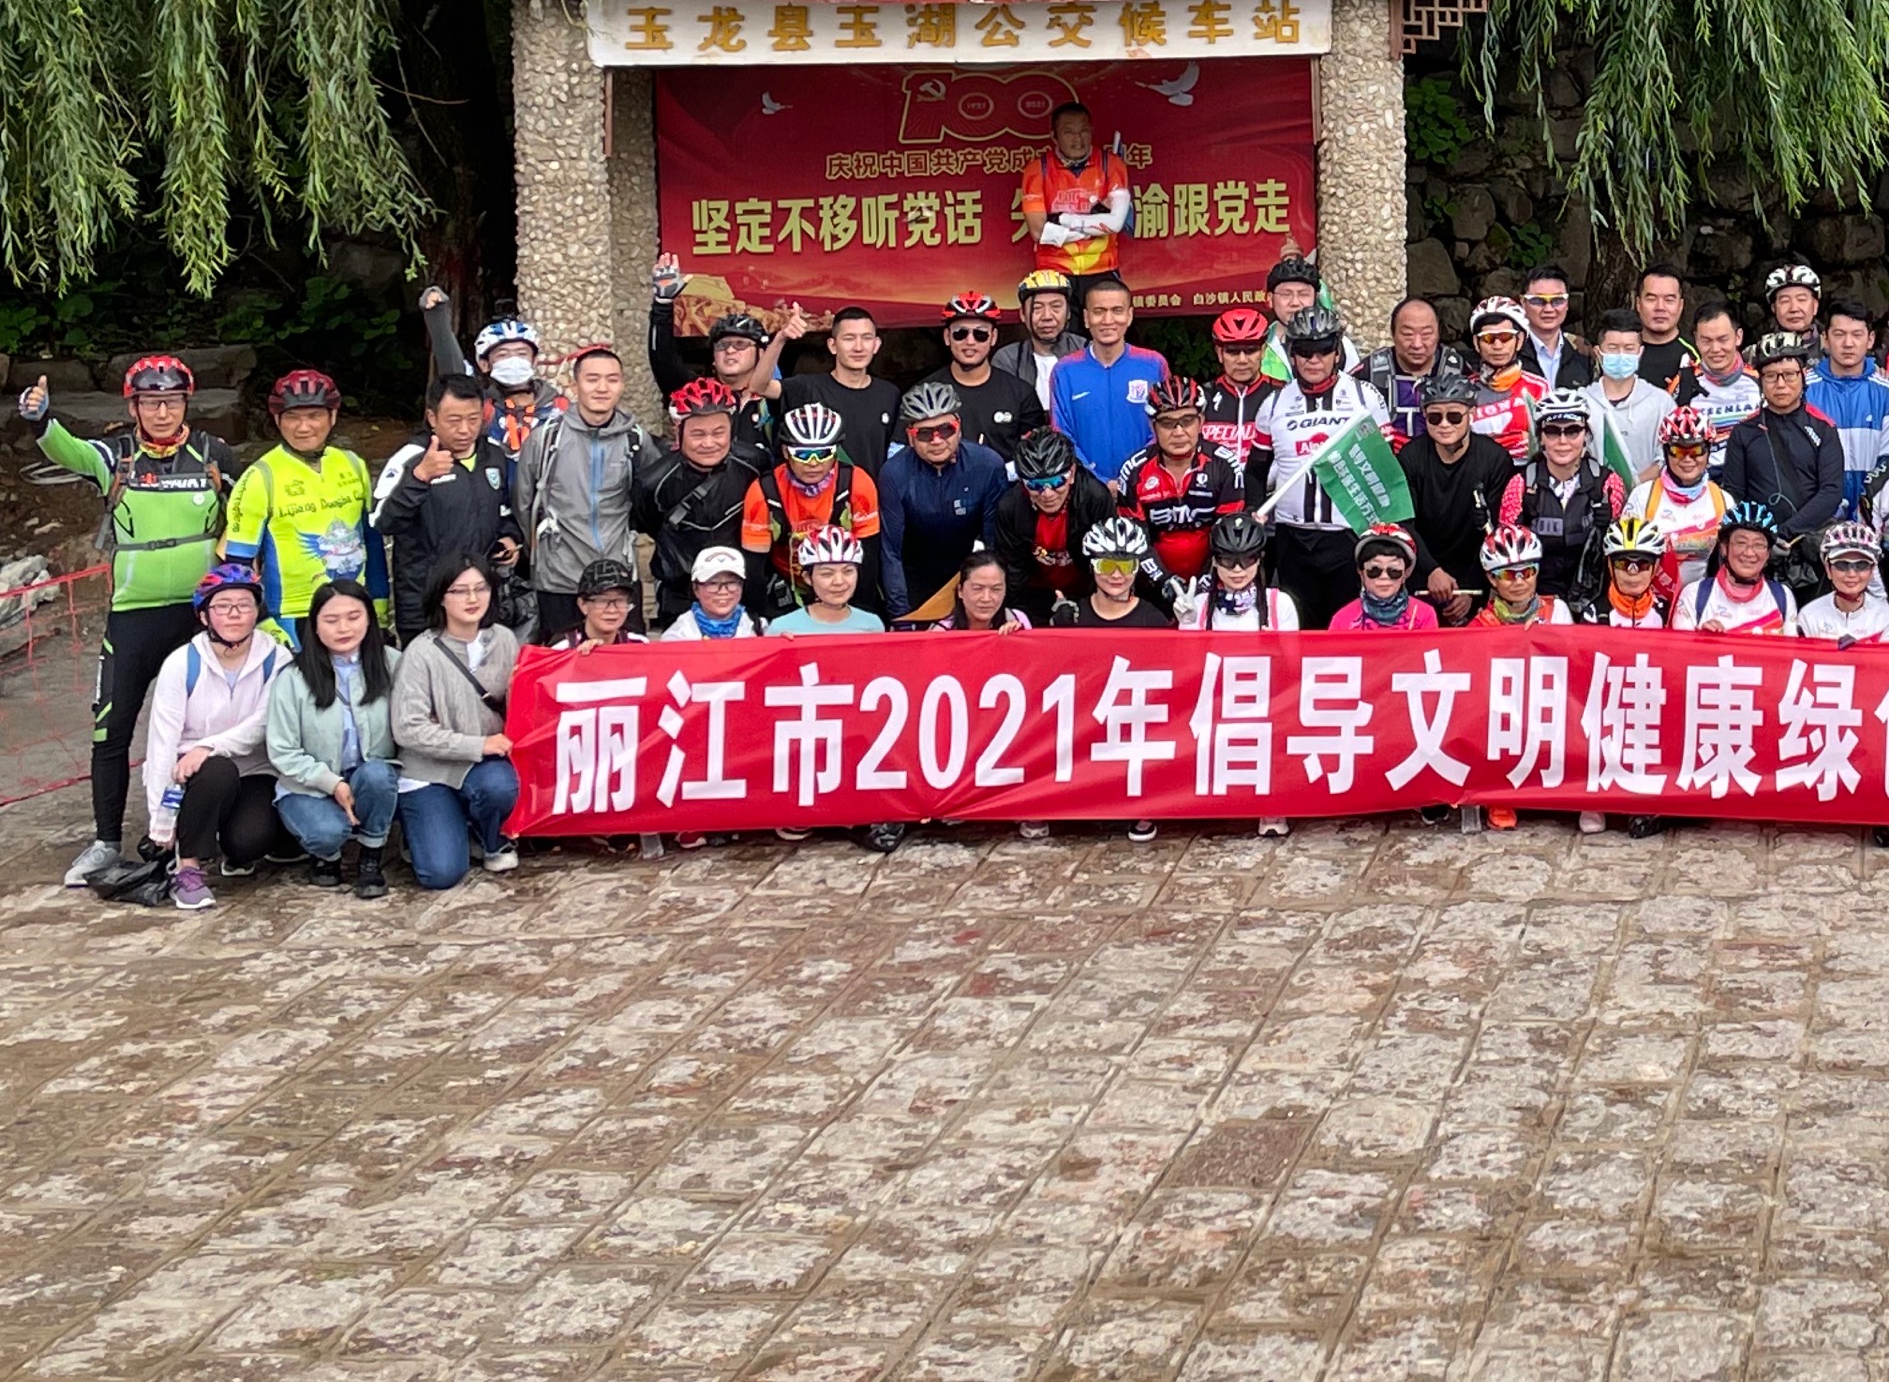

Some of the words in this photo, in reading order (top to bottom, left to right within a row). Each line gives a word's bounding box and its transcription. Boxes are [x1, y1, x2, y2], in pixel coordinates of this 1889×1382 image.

[691, 190, 984, 256] 坚定不移听党话
[1193, 290, 1269, 306] 白沙镇人民政
[1149, 504, 1216, 526] BMC
